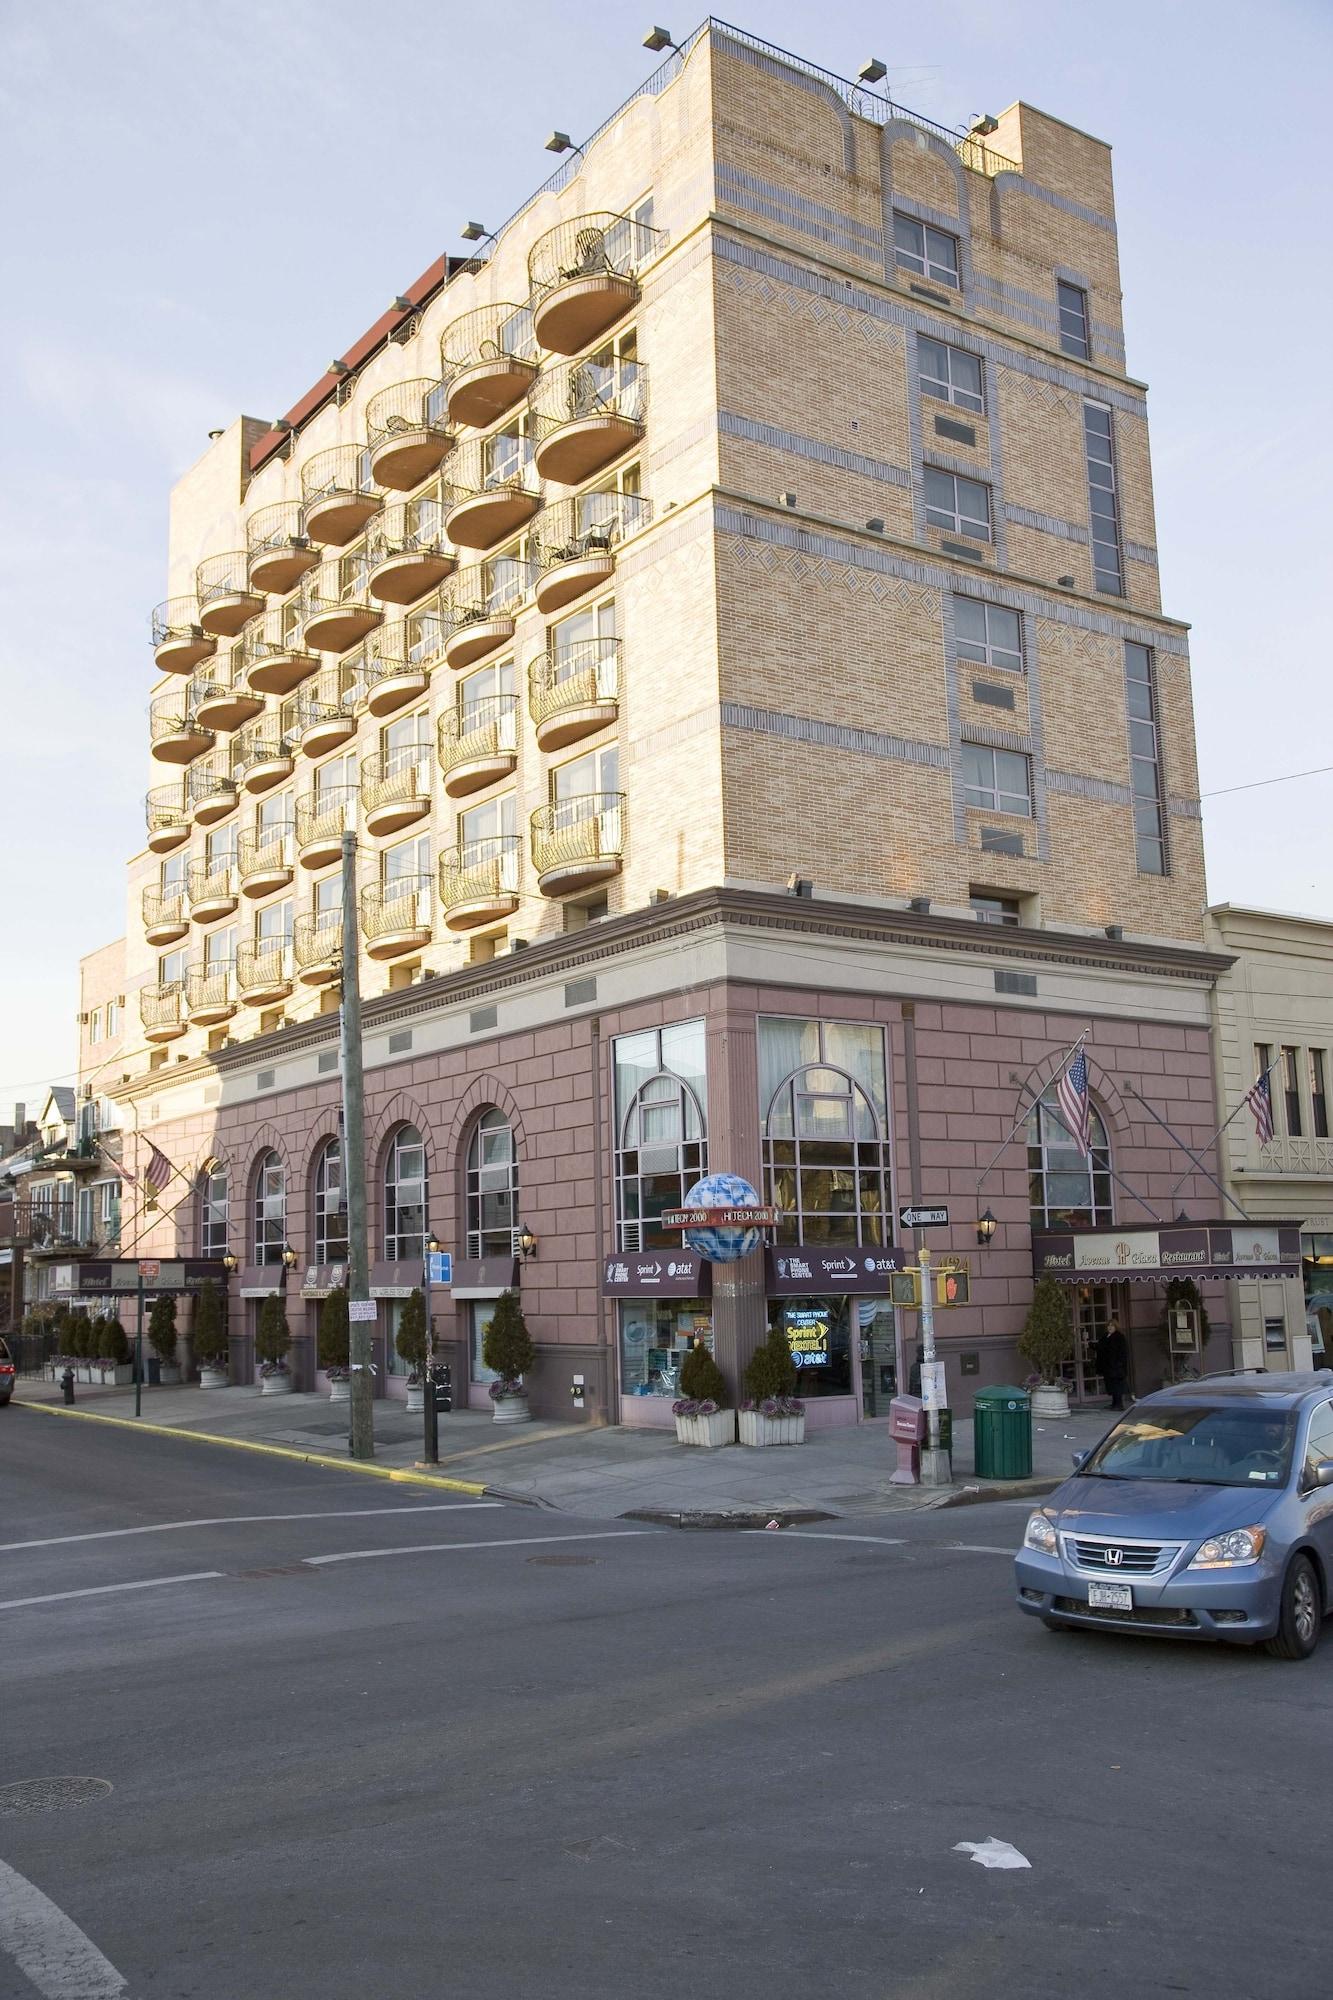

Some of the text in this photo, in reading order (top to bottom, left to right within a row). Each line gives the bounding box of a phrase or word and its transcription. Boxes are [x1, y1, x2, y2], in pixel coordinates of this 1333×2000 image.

[690, 1212, 707, 1223] 2000
[755, 1211, 769, 1221] 2000
[906, 1211, 945, 1222] ONE WAY
[876, 1259, 896, 1270] at&t
[1044, 1250, 1206, 1267] Hotel Avenue Plaza Restaurant
[637, 1264, 654, 1276] Sprint
[676, 1262, 693, 1274] at&t
[821, 1259, 845, 1271] Sprint
[787, 1326, 817, 1340] Sprint
[803, 1352, 827, 1364] at&t
